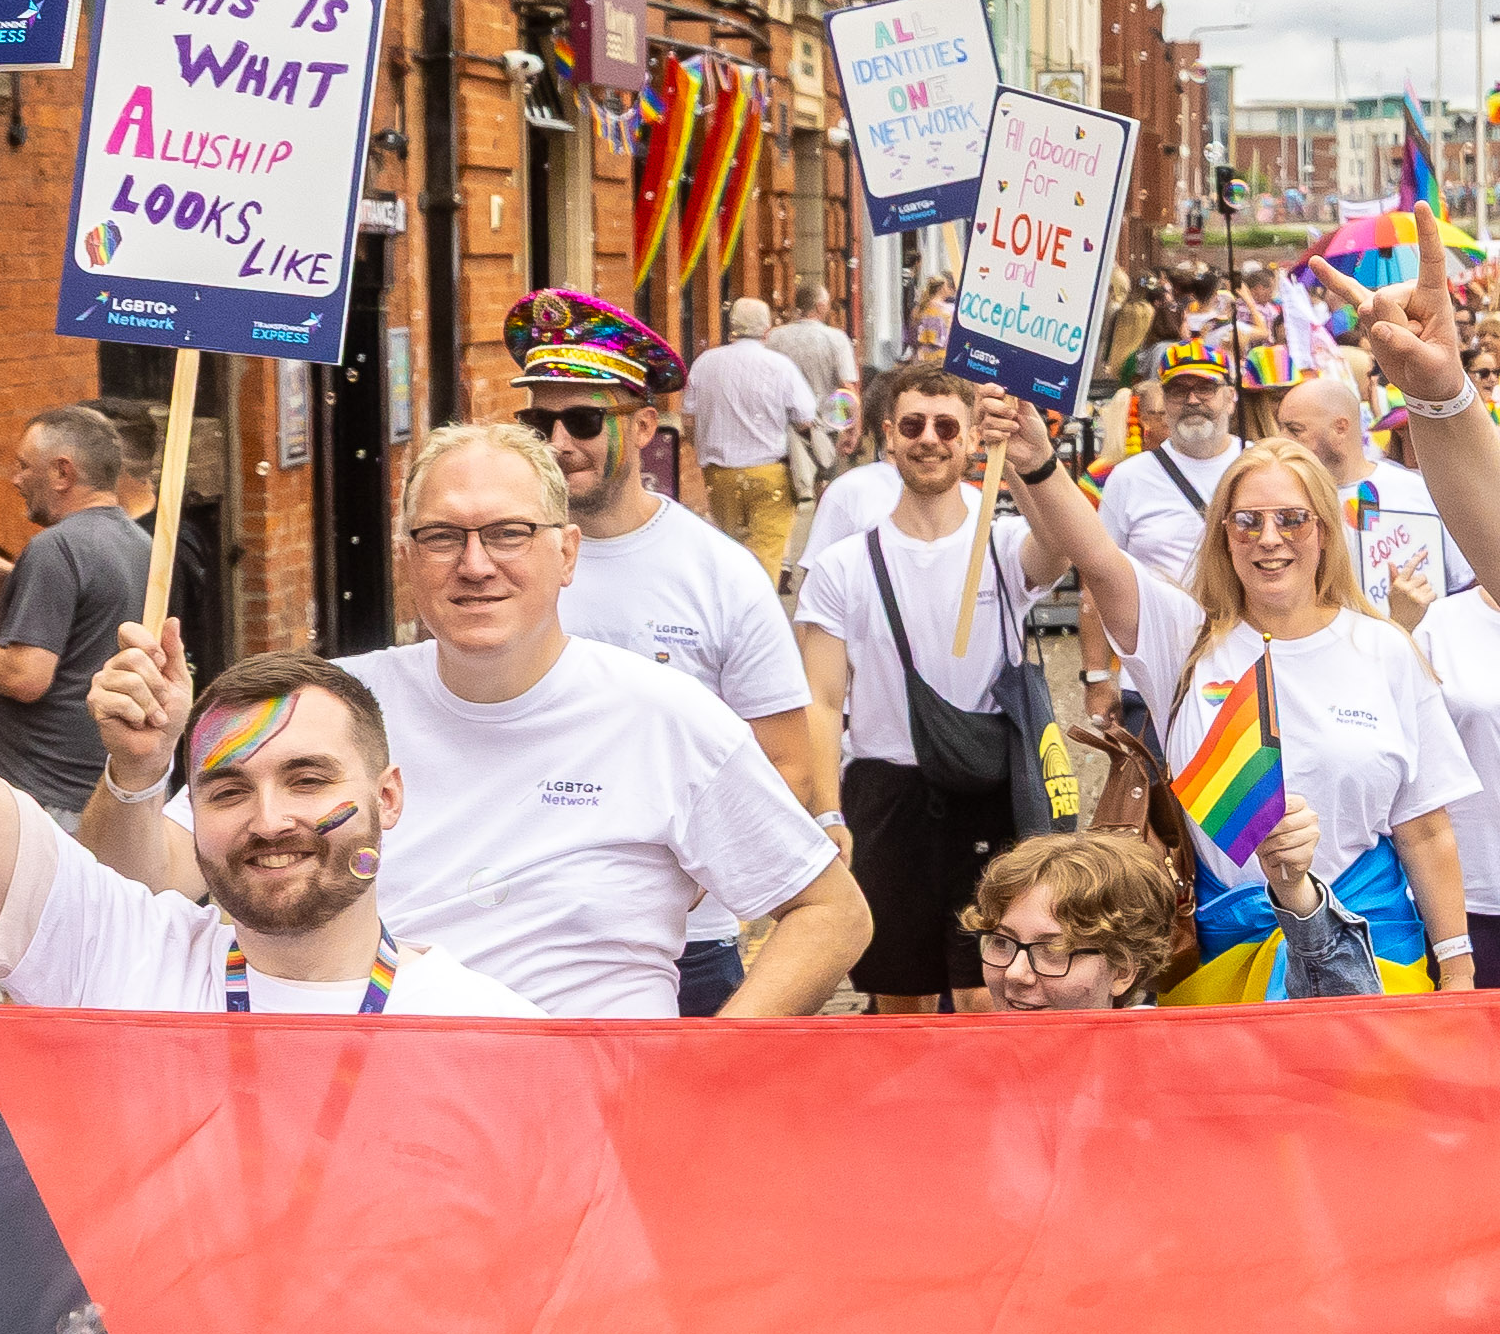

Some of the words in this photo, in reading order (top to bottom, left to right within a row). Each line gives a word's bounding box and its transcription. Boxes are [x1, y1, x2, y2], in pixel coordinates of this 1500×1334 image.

[873, 11, 939, 50] ALL
[173, 33, 350, 110] WHAT
[850, 37, 970, 86] IDENTITIES
[887, 73, 953, 114] ONE
[868, 100, 983, 150] NETWORK
[1004, 117, 1026, 151] All
[1027, 126, 1104, 178] aboard
[1017, 165, 1060, 209] for
[110, 173, 265, 247] LOOKS
[990, 206, 1076, 270] LOVE
[239, 235, 333, 288] LIKE
[1003, 260, 1038, 290] and
[107, 312, 176, 332] Network
[111, 297, 179, 316] LGBTQ+
[958, 289, 1086, 355] acceptance
[251, 328, 310, 345] EXPRESS
[1369, 524, 1410, 568] LOVE
[653, 633, 699, 648] Network
[655, 623, 700, 637] LGBTQ+
[540, 793, 600, 808] Network
[545, 780, 604, 794] LGBTQ+
